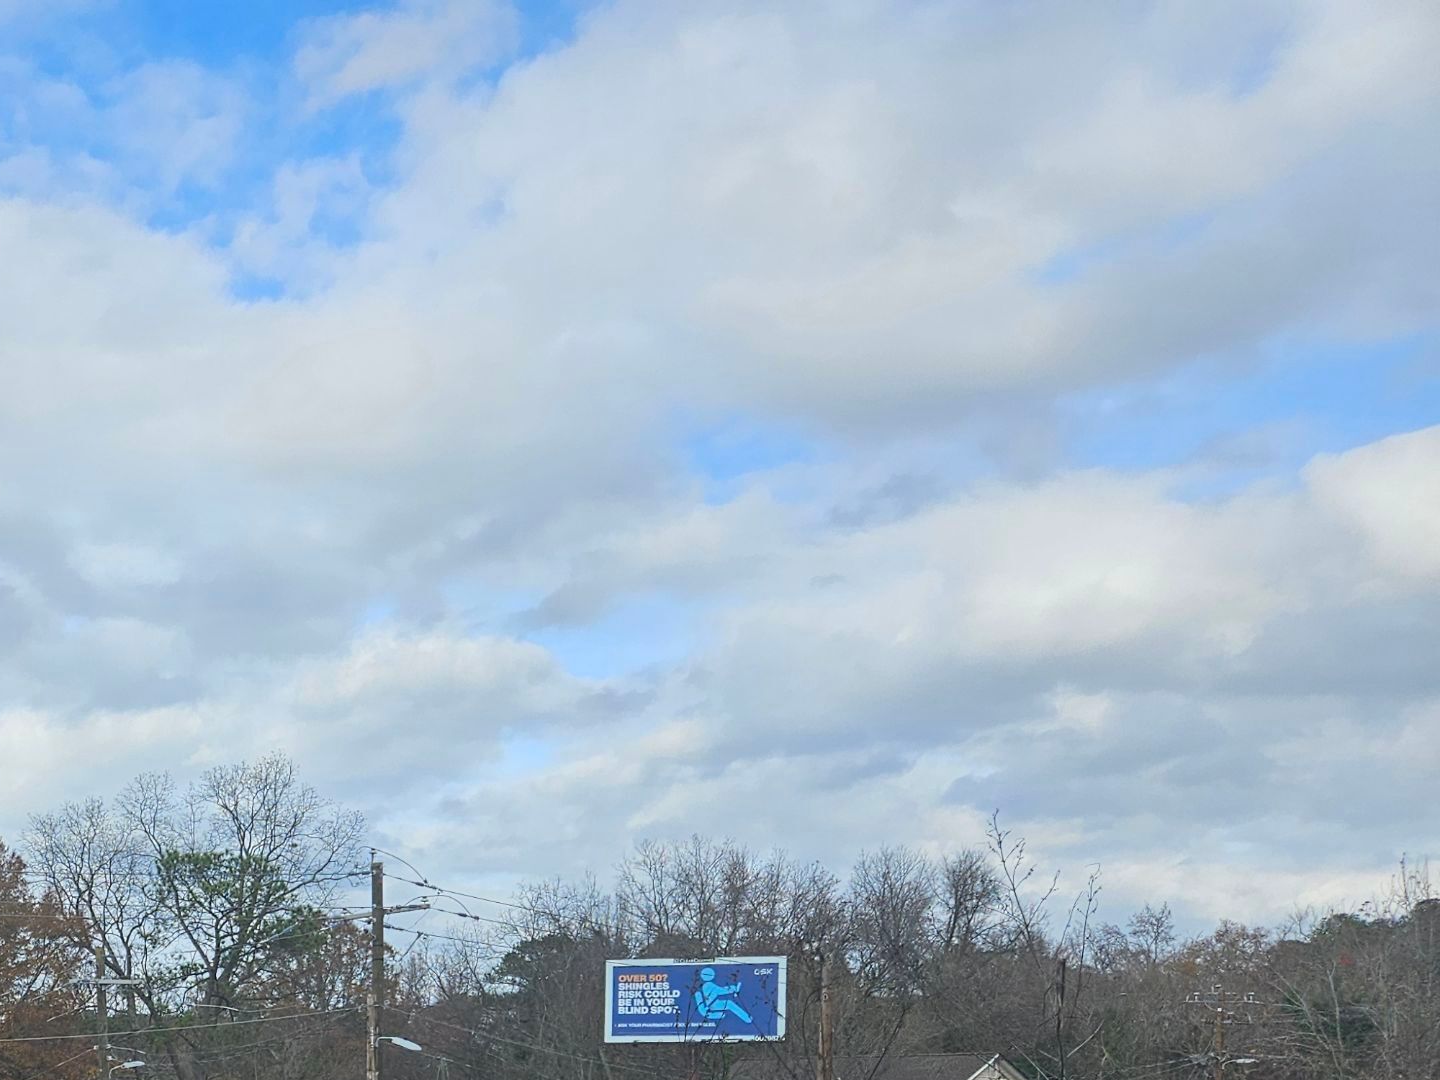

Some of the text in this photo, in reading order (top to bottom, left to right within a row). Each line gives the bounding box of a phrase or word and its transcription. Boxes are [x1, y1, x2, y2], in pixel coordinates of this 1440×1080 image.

[618, 973, 668, 983] OVER 50?
[618, 982, 670, 991] SHINGLES
[618, 990, 680, 999] RISK COULD
[618, 998, 675, 1006] BE IN YOUR
[618, 1006, 649, 1014] BLIND
